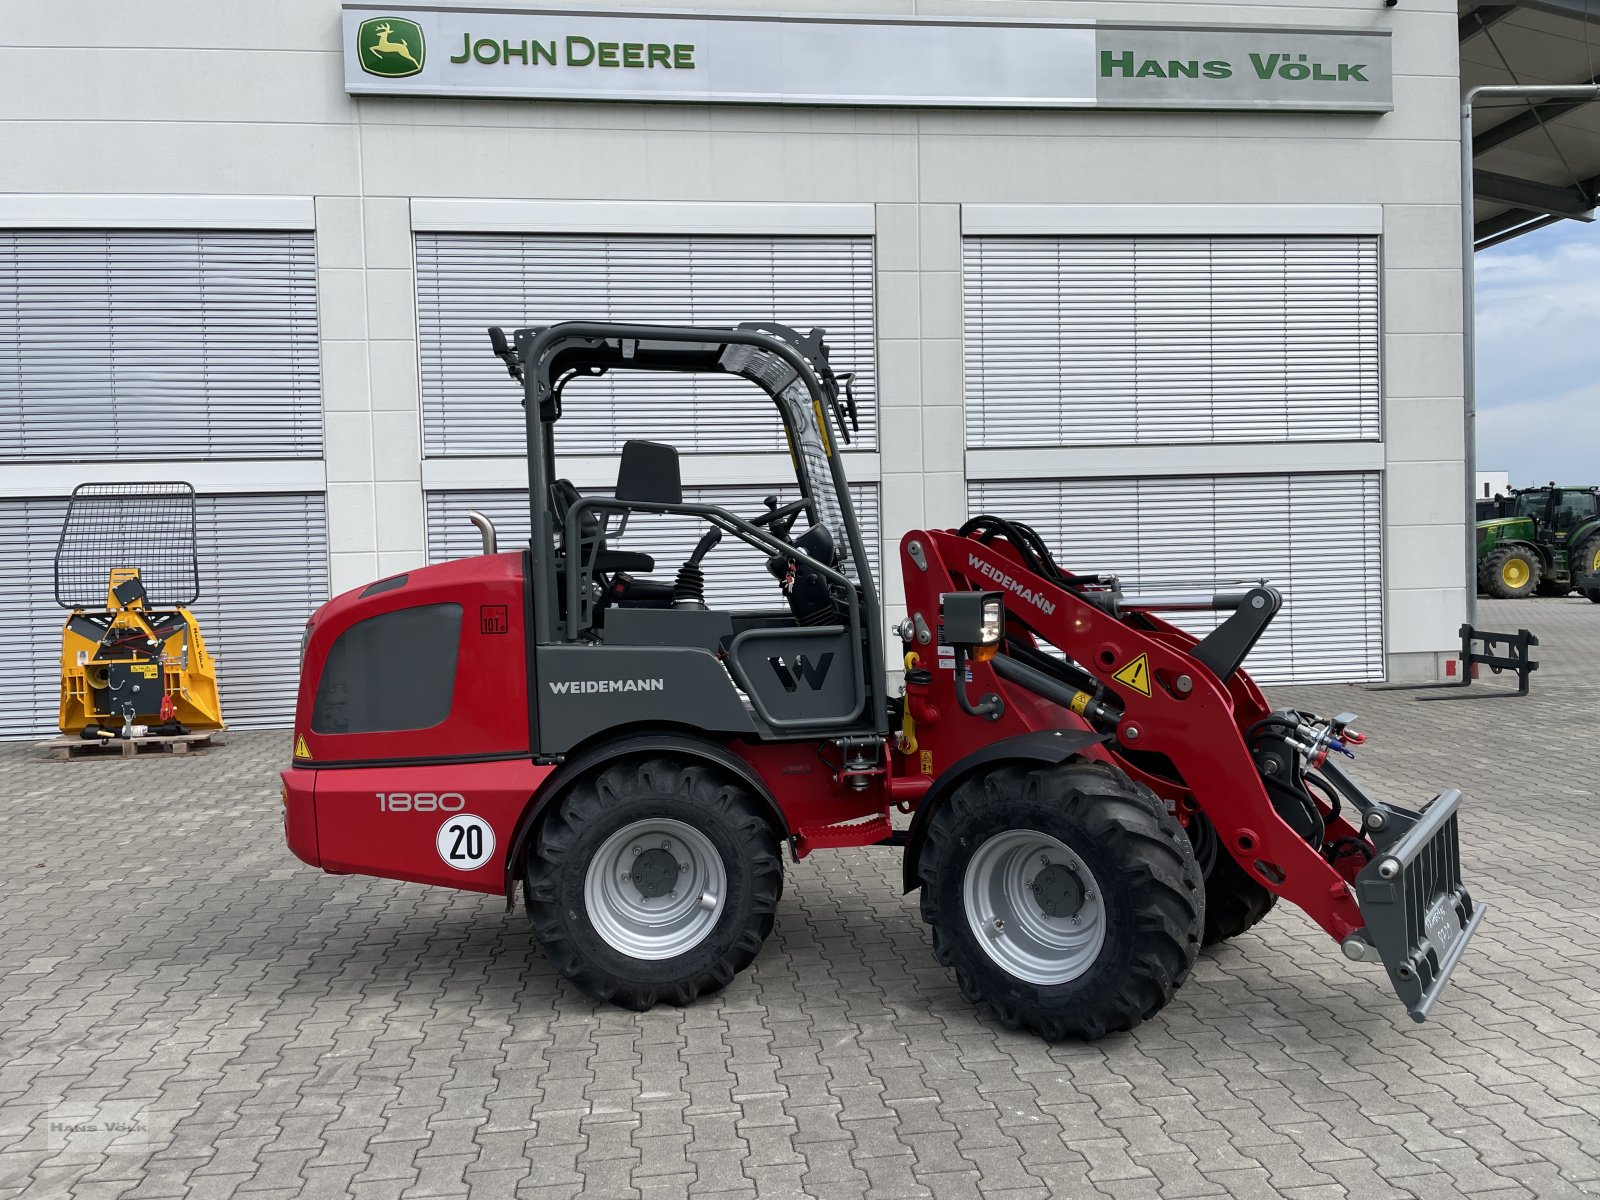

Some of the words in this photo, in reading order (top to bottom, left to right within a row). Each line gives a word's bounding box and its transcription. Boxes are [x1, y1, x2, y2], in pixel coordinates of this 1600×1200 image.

[450, 33, 557, 65] JOHN
[566, 35, 695, 69] DEERE
[1100, 50, 1233, 79] HANS
[1248, 53, 1369, 82] VÖLK
[968, 552, 1056, 616] WEIDEMANN
[483, 618, 499, 632] 101
[548, 678, 664, 694] WEIDEMANN
[375, 792, 466, 812] 1880
[448, 824, 483, 860] 20
